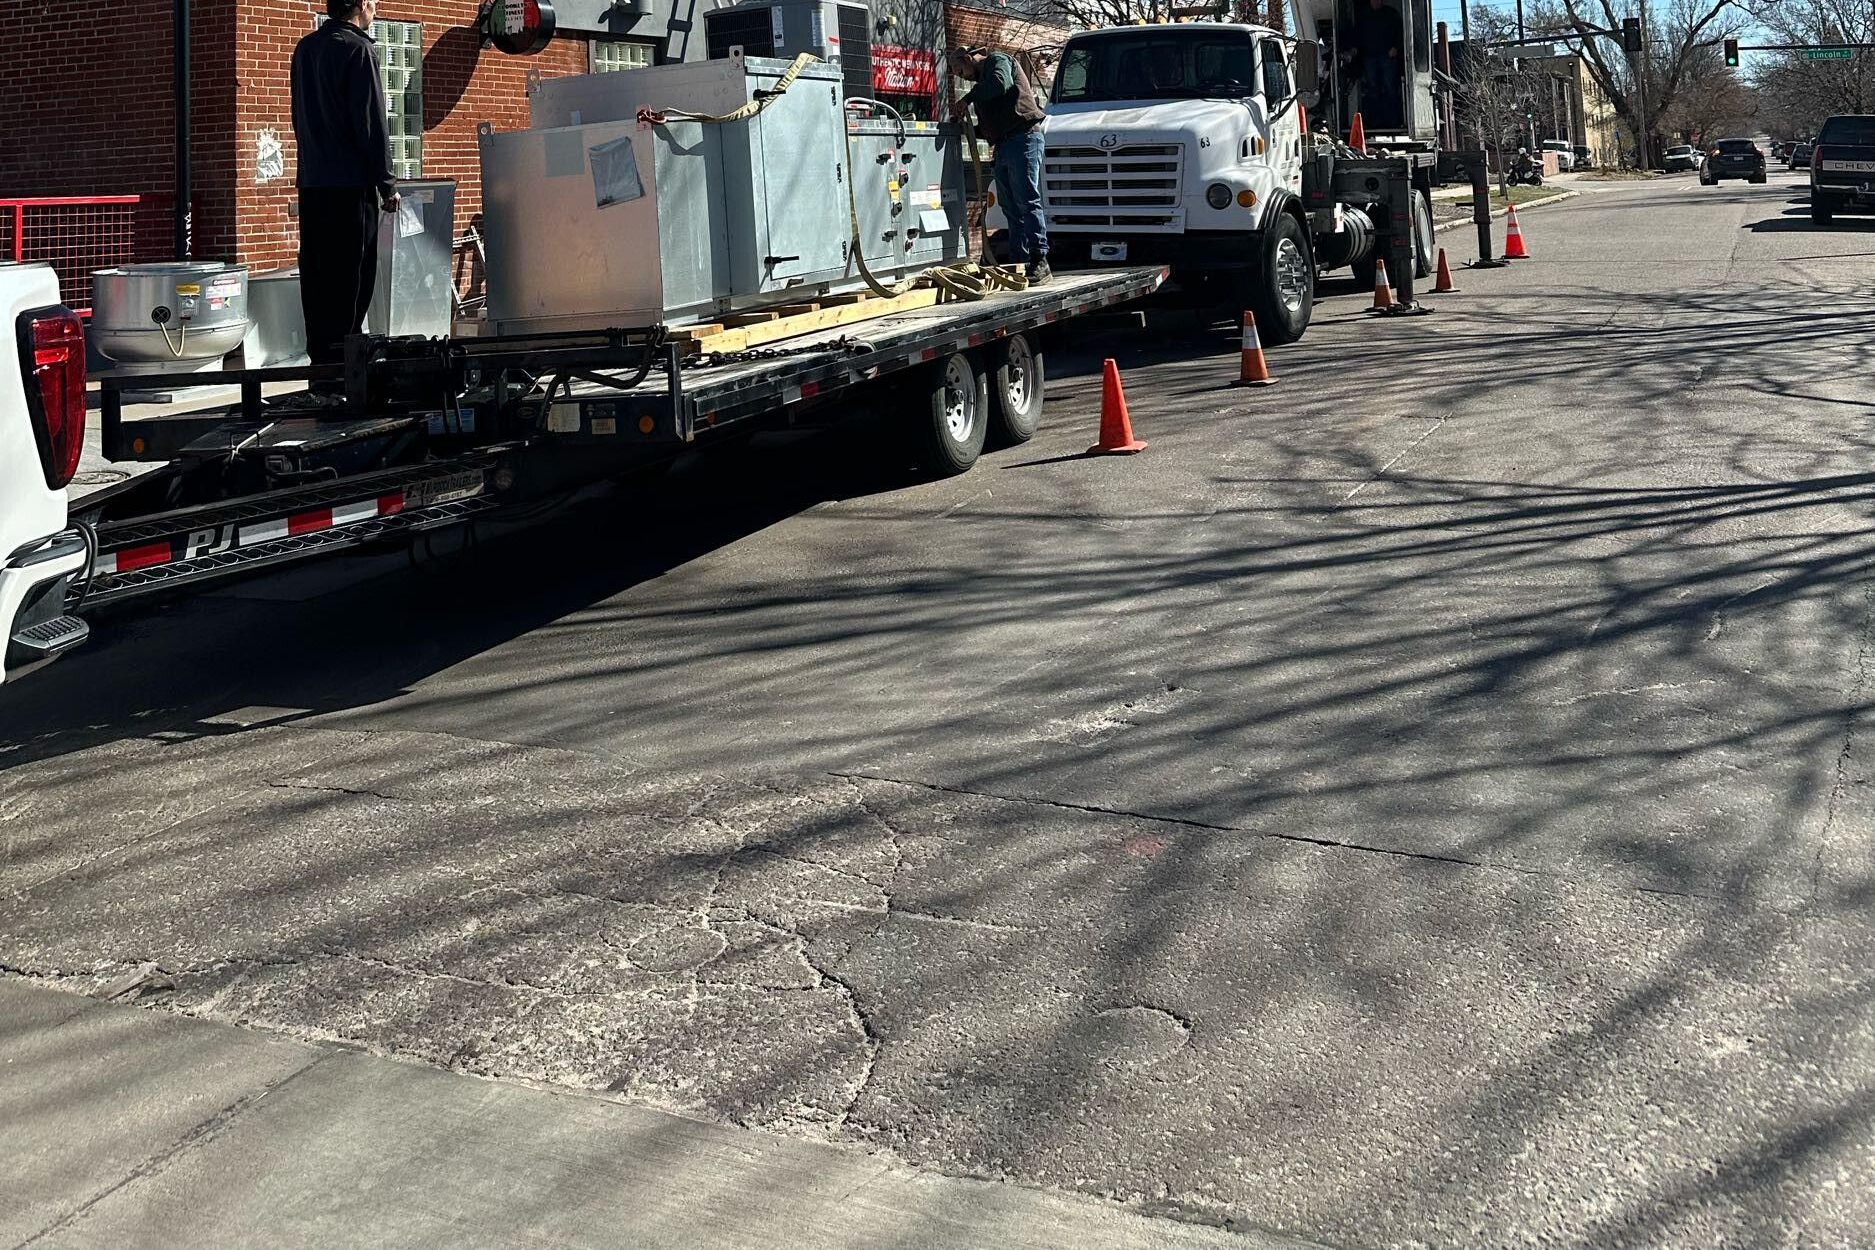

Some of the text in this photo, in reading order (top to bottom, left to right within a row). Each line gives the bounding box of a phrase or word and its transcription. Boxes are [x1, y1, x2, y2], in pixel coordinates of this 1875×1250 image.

[1812, 51, 1841, 59] Lincoln
[871, 56, 902, 68] UTHENTIC
[885, 67, 913, 88] Italian
[1100, 134, 1117, 147] 63
[1200, 137, 1211, 148] 63
[184, 524, 235, 560] PJ
